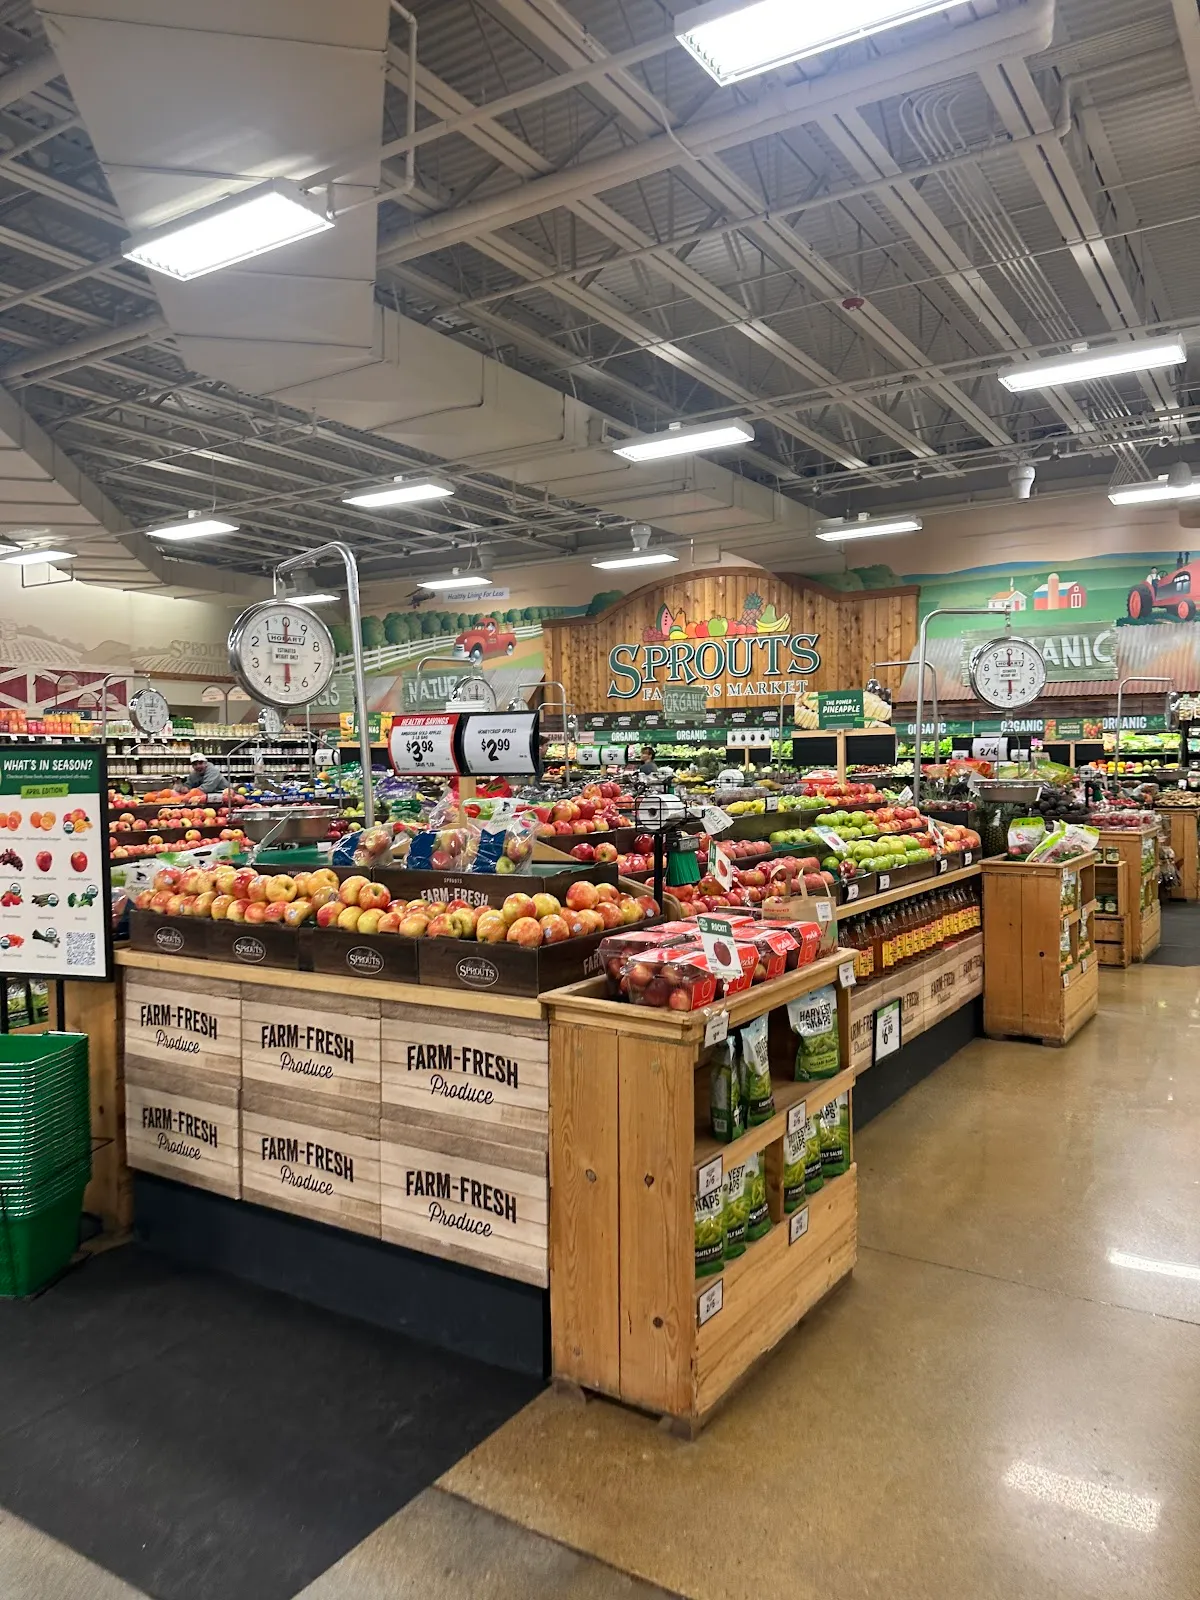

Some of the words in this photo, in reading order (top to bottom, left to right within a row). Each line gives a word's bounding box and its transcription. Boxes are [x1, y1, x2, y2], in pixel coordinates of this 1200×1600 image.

[448, 591, 466, 600] Healthy
[467, 591, 482, 599] Living
[265, 620, 270, 631] 1
[282, 616, 290, 628] 0
[301, 624, 308, 635] 9
[252, 636, 259, 647] 2
[313, 642, 320, 652] 8
[252, 657, 259, 668] 3
[314, 662, 321, 673] 7
[607, 634, 821, 698] SPROUTS
[264, 675, 272, 686] 4
[284, 682, 290, 692] 5
[302, 677, 308, 687] 6
[642, 684, 722, 701] FARS
[727, 680, 808, 696] MARKET
[665, 692, 706, 712] ORGANIC
[823, 705, 860, 713] PINEAPPLE
[425, 717, 449, 725] SAVINGS
[611, 731, 640, 741] ORGANIC
[676, 730, 707, 740] ORGANIC
[3, 759, 36, 771] WHAT'S
[39, 759, 50, 770] IN
[52, 759, 93, 771] SEASON?
[706, 808, 726, 829] PROUT
[421, 887, 489, 907] FARM-FRESH
[711, 921, 727, 933] ROCKIT
[350, 954, 381, 966] SPROUTS
[460, 965, 494, 977] SPROUTS
[800, 1003, 831, 1021] HARVEST
[140, 1004, 217, 1040] FARM-FRESH
[807, 1015, 830, 1029] SNAPS
[156, 1029, 200, 1055] Produce
[261, 1024, 354, 1064] FARM-FRESH
[280, 1052, 334, 1079] Produce
[407, 1044, 518, 1089] FARM-FRESH
[430, 1074, 494, 1105] Produce
[820, 1109, 836, 1120] APS
[142, 1106, 218, 1148] FARM-FRESH
[157, 1132, 201, 1160] Produce
[261, 1137, 354, 1183] FARM-FRESH
[728, 1165, 745, 1180] VEST
[280, 1165, 334, 1196] Produce
[729, 1178, 740, 1194] APS
[406, 1170, 517, 1224] FARM-FRESH
[696, 1193, 720, 1211] NAPS
[428, 1201, 492, 1237] Produce
[696, 1248, 711, 1257] IGHTLY
